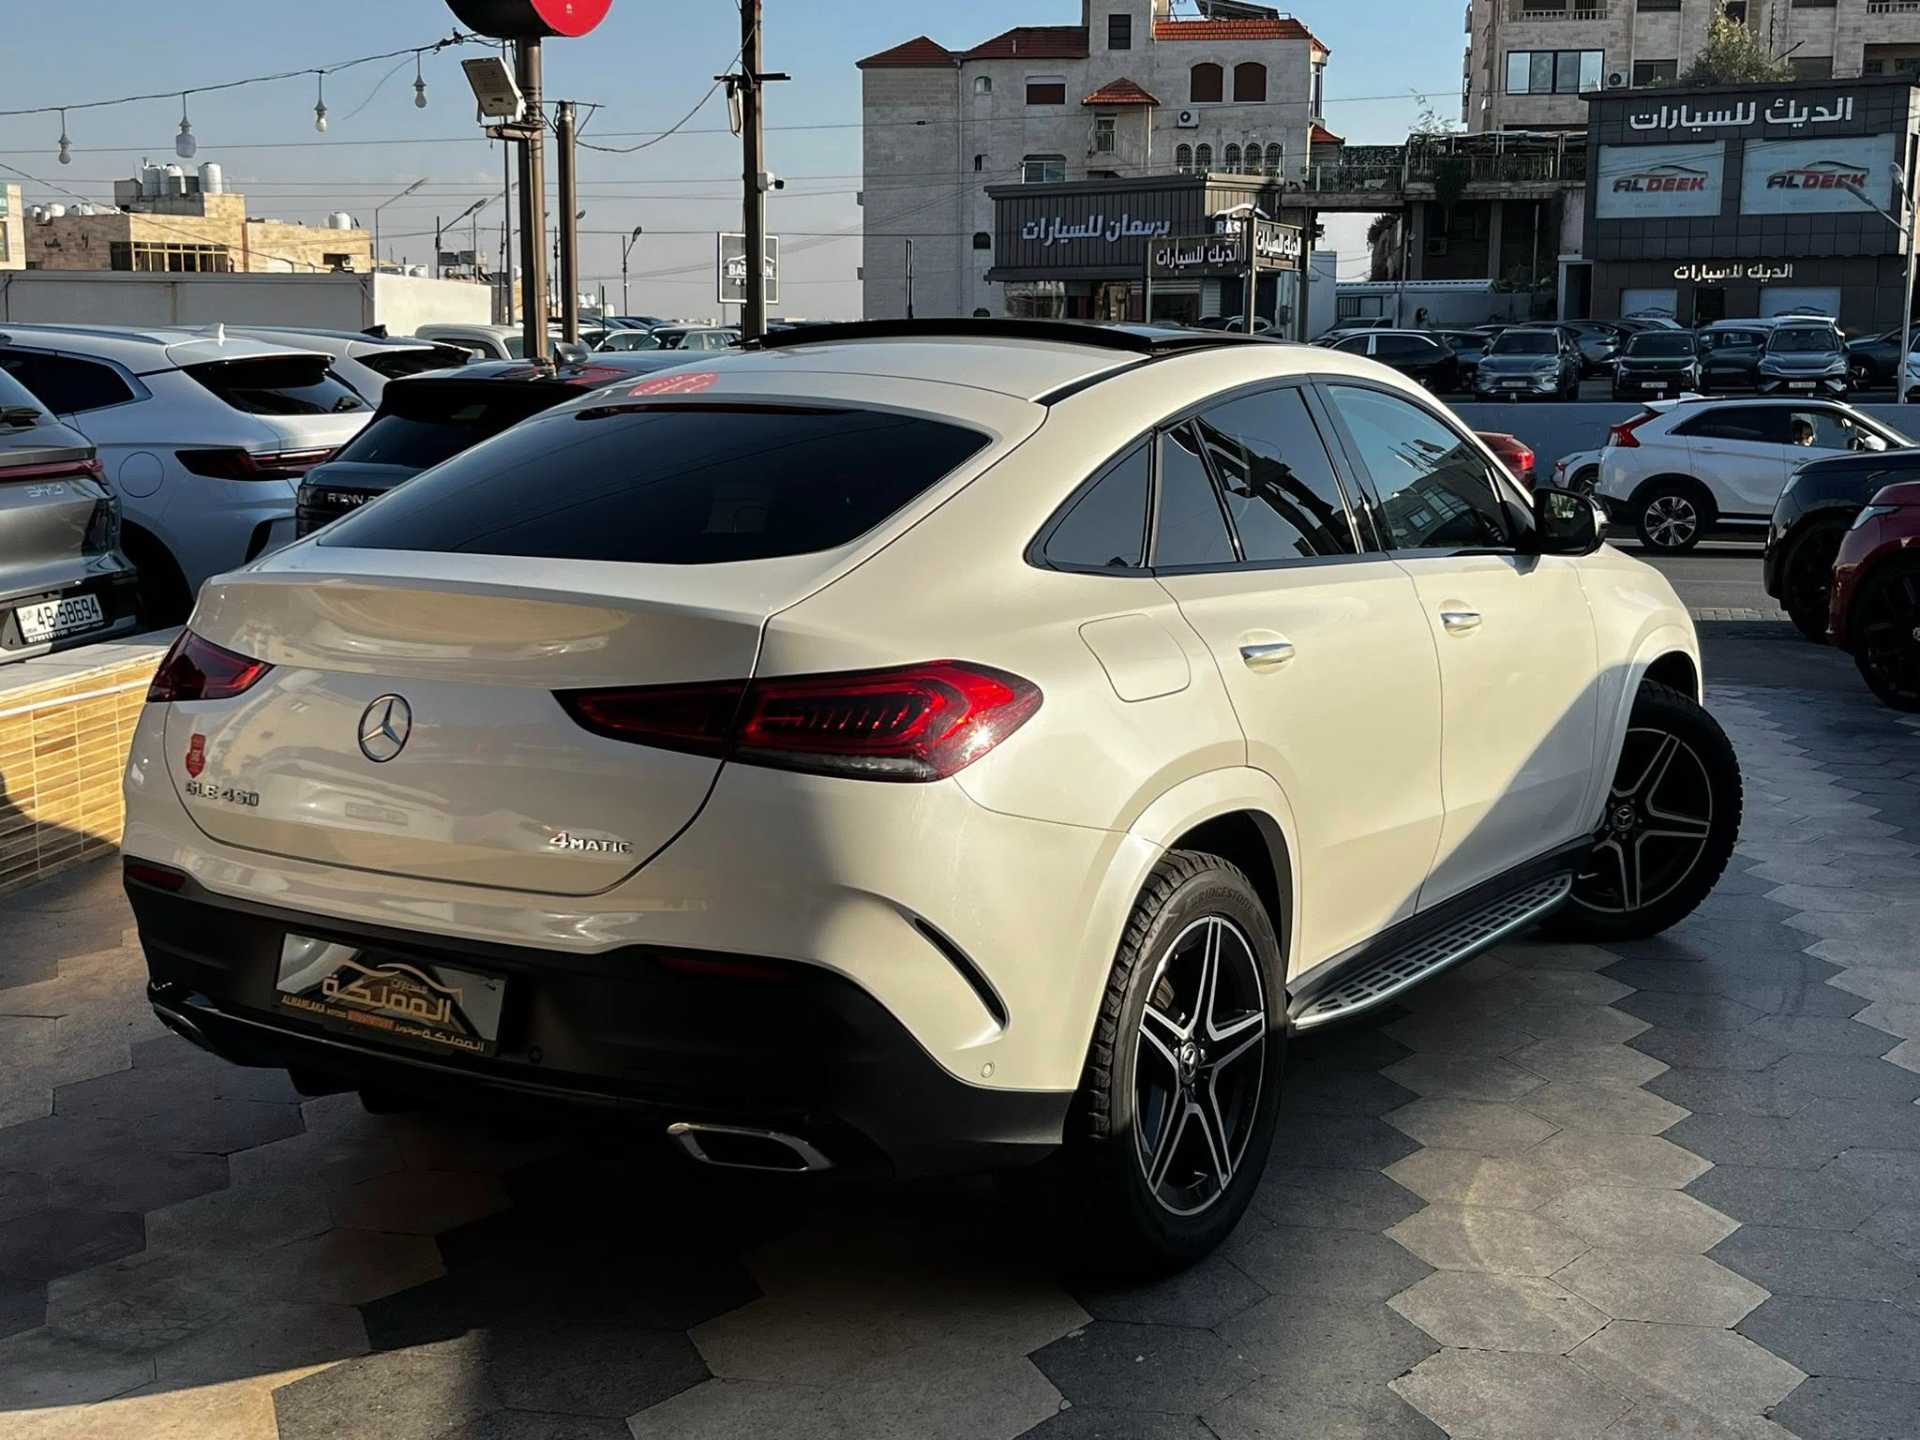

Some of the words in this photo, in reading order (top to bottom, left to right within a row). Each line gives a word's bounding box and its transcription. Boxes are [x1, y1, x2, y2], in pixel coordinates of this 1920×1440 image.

[1629, 101, 1756, 132] للسيارات
[1764, 96, 1854, 128] الديك
[1612, 176, 1706, 193] ALDEEK
[1022, 215, 1104, 246] للسيارات
[1155, 245, 1205, 269] للسيارات
[1207, 242, 1242, 268] الديك
[1673, 264, 1743, 283] للسيارات
[1747, 263, 1793, 282] الديك
[548, 830, 634, 854] 4MATIC
[321, 972, 452, 1024] المملكة
